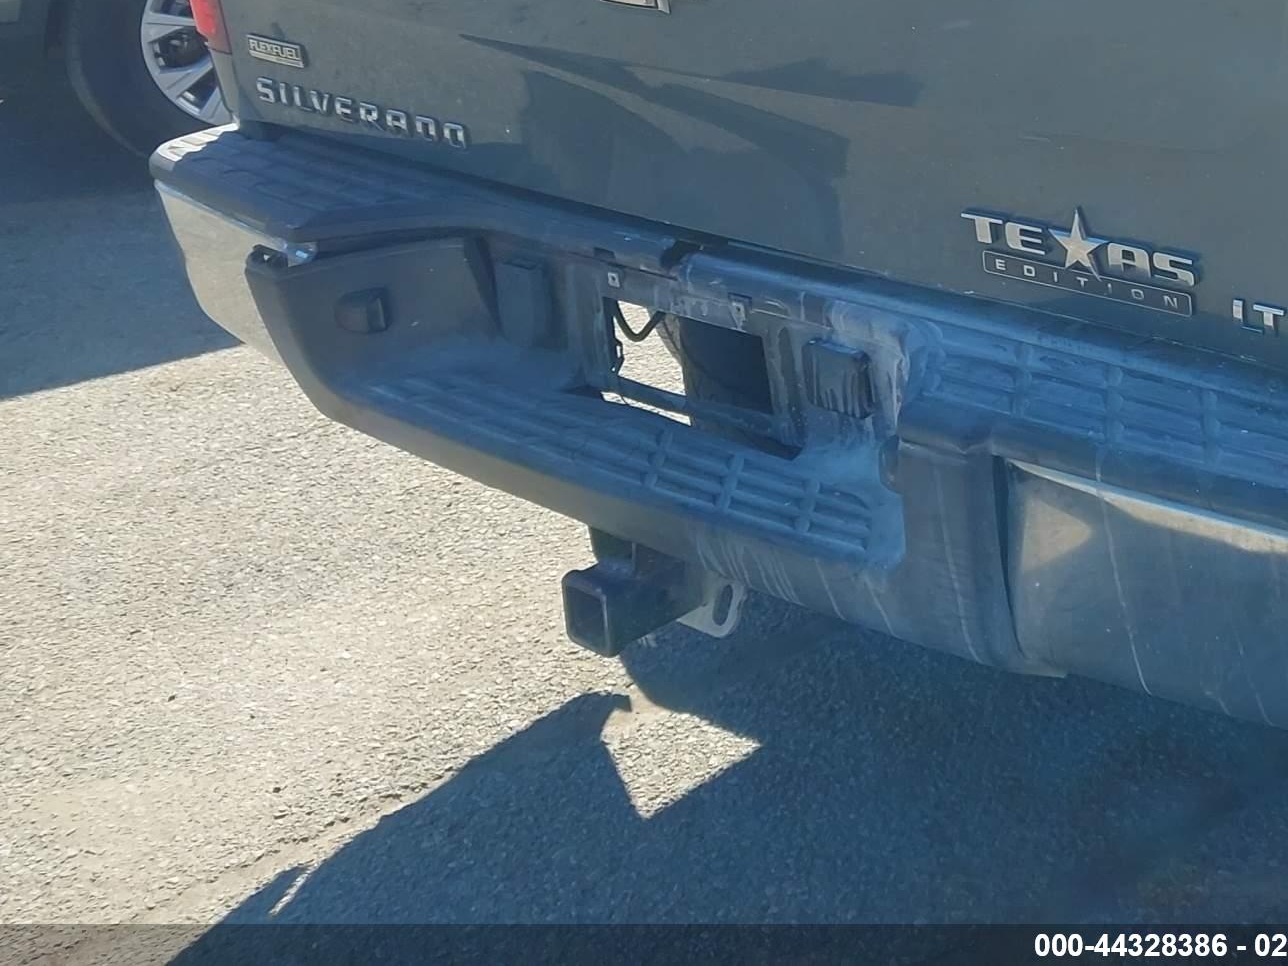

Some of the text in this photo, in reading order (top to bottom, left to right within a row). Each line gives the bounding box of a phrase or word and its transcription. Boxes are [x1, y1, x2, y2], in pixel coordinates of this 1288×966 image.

[248, 38, 302, 60] FLEXFUEL
[256, 77, 467, 149] SILVERADO
[960, 208, 1196, 287] TEXAS
[995, 258, 1179, 309] EDITION
[1232, 298, 1286, 335] LT
